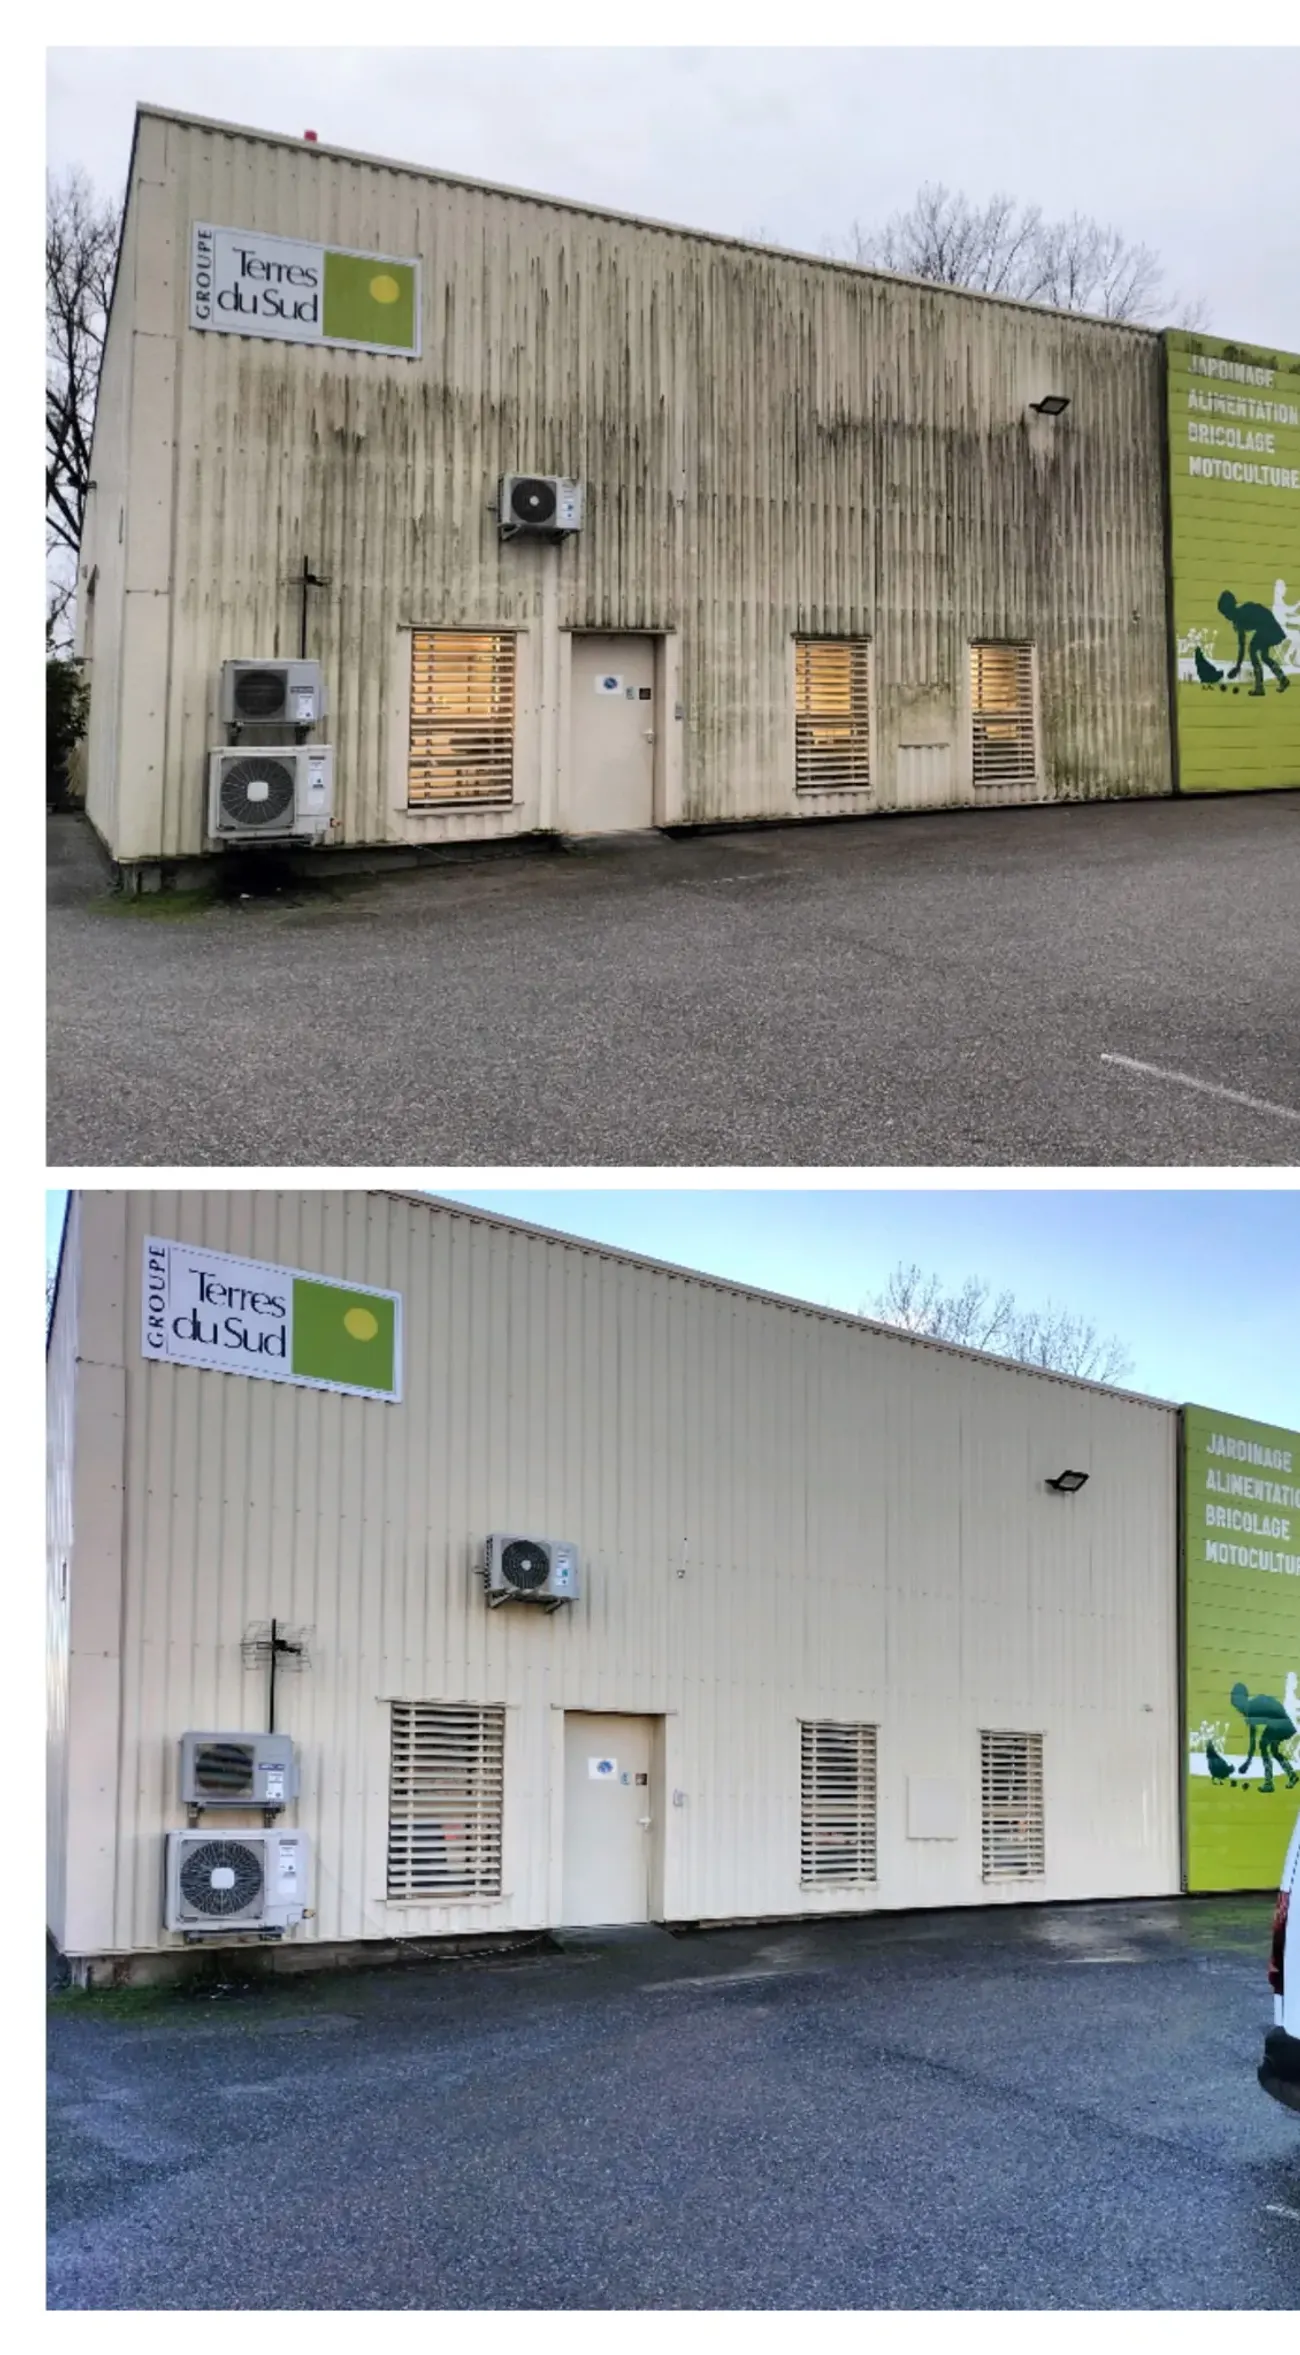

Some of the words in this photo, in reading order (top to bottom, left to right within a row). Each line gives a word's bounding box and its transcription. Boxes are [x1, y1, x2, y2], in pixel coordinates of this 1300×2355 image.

[196, 228, 213, 319] GROUPE
[232, 247, 318, 288] Terres
[217, 281, 258, 314] du
[262, 288, 318, 323] Sud
[1188, 355, 1277, 388] JARDINAGE
[1188, 388, 1299, 425] ALIMENTATION
[1188, 421, 1276, 453] BRICOLAGE
[1189, 455, 1300, 489] MOTOCULTURE
[147, 1245, 166, 1349] GROUPE
[188, 1267, 287, 1319] Terres
[172, 1308, 218, 1345] du
[223, 1316, 286, 1358] Sud
[1206, 1433, 1293, 1473] JARDINAGE
[1205, 1504, 1291, 1542] BRICOLAGE
